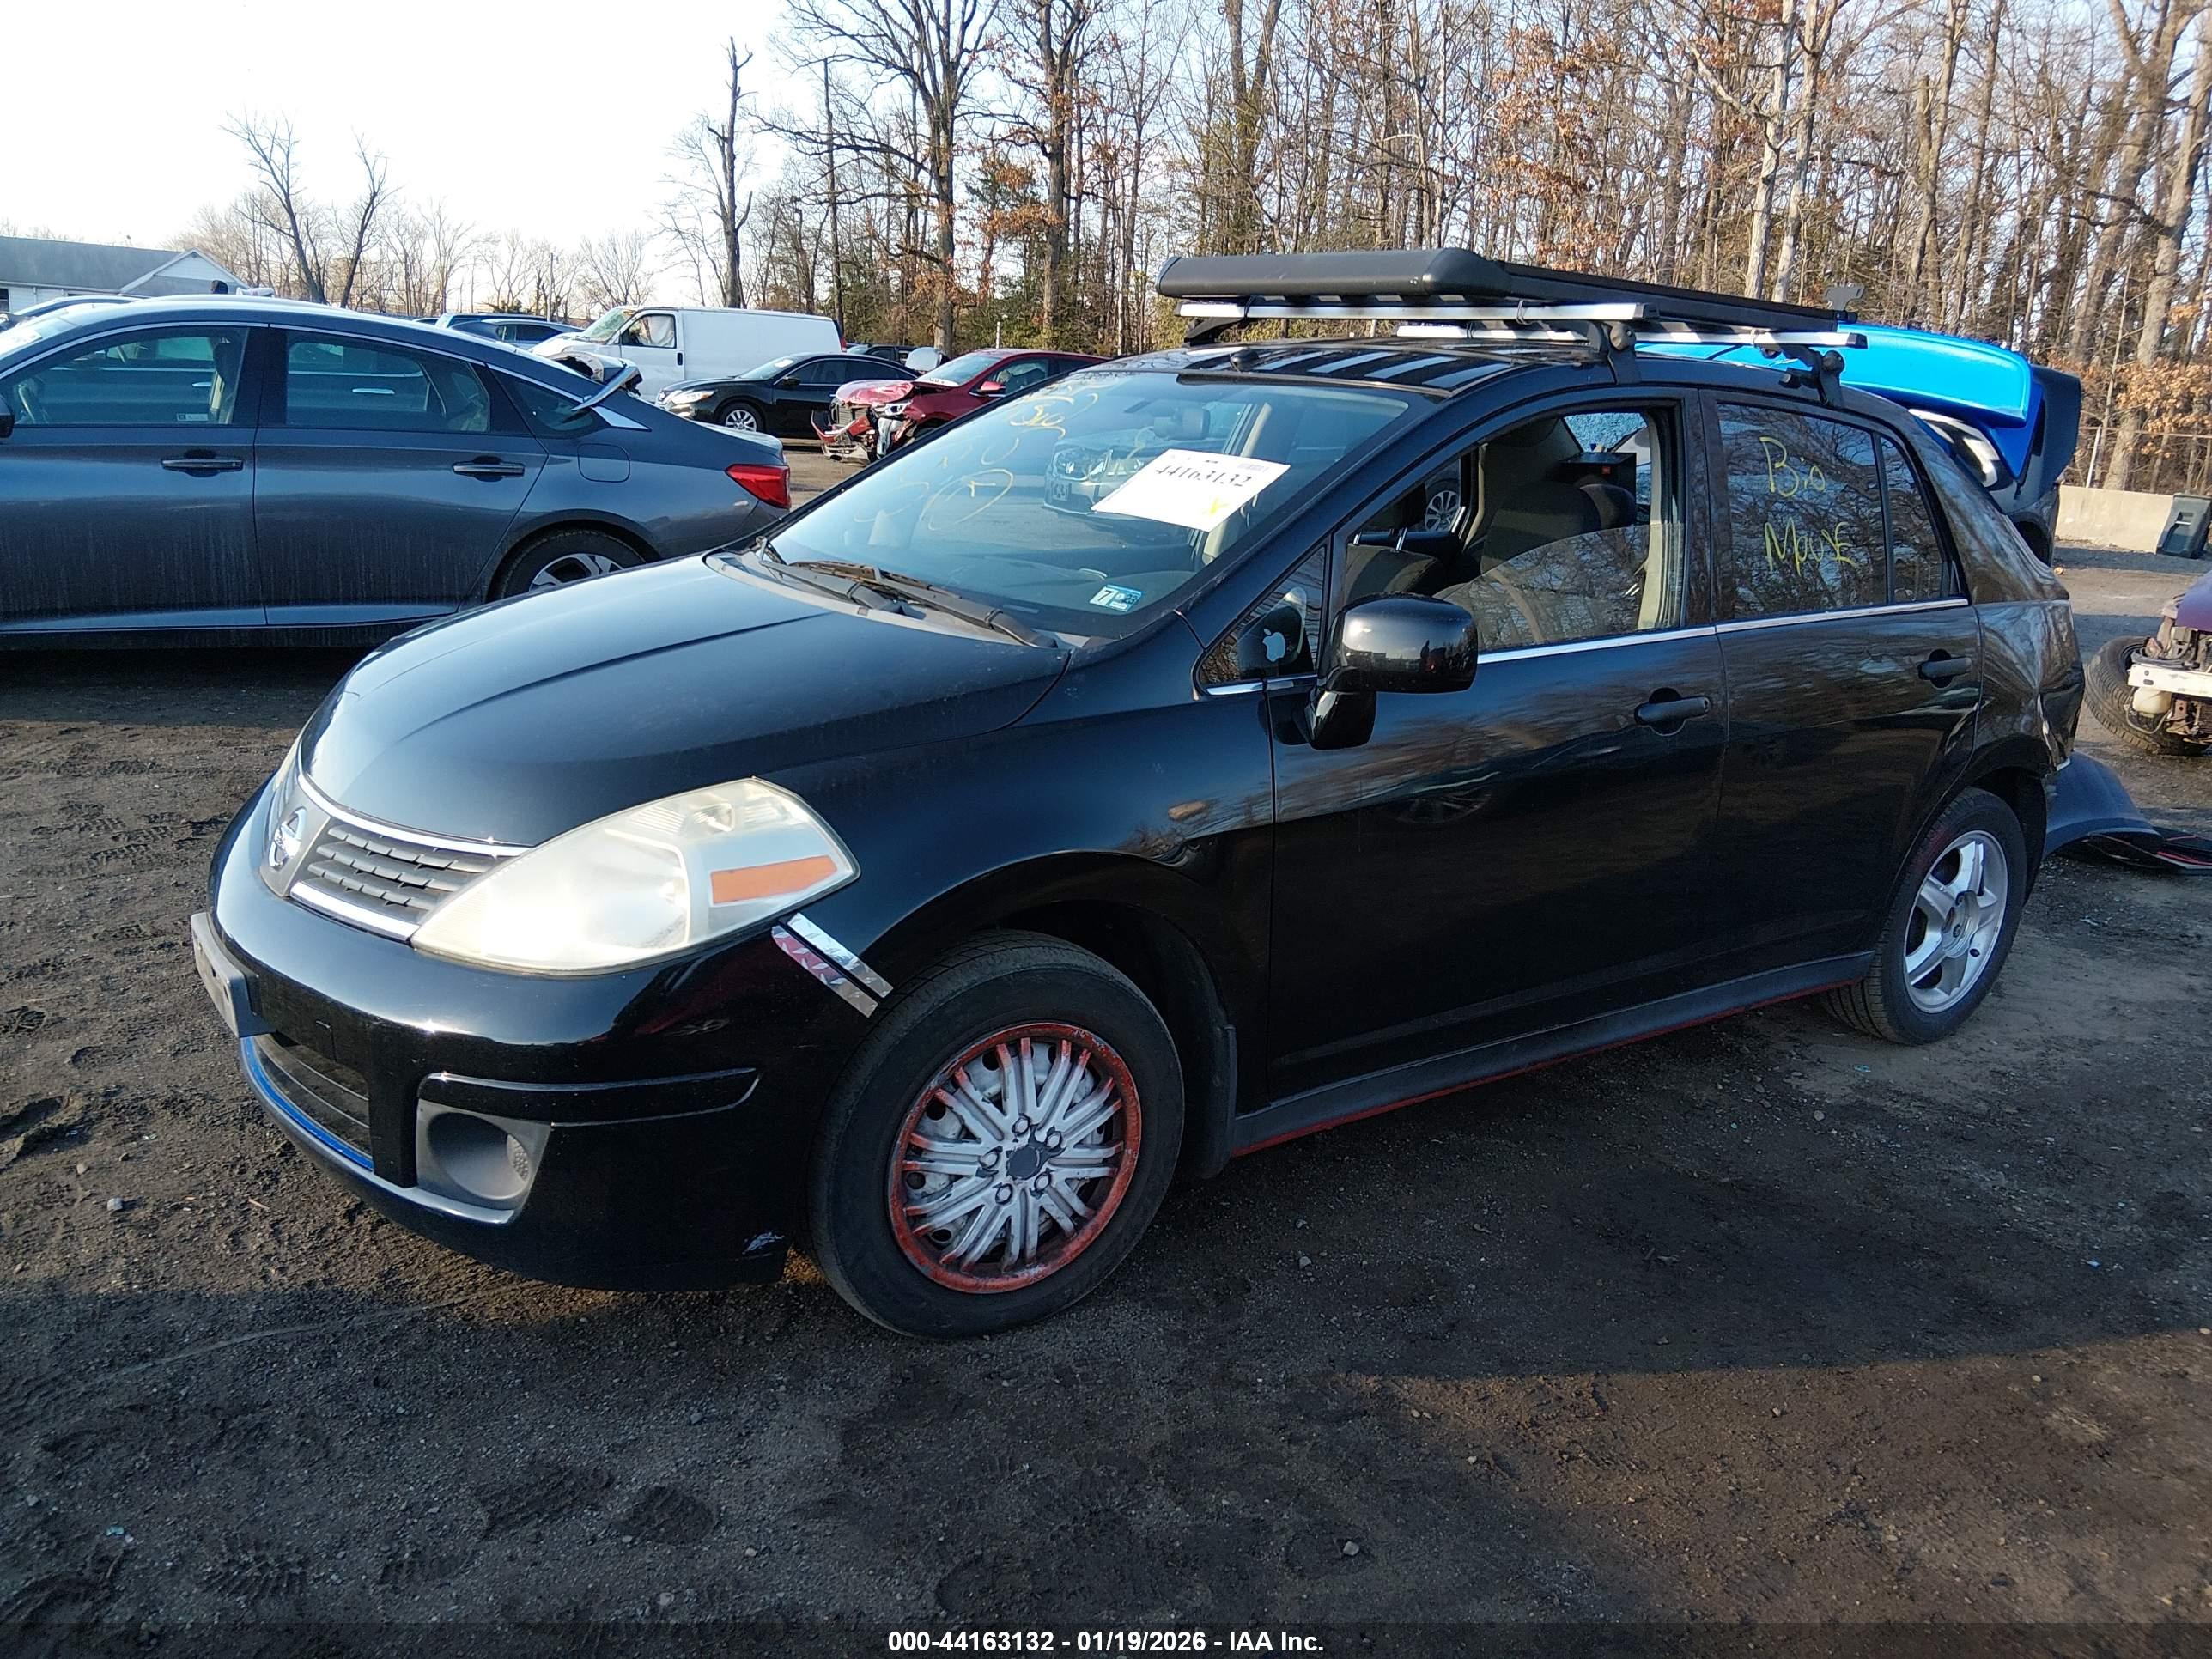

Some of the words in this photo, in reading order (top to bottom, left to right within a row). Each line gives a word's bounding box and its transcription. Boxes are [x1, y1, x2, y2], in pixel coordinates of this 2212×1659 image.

[1155, 465, 1253, 487] 44163132
[1759, 436, 1826, 497] Bio
[1097, 589, 1114, 602] 7
